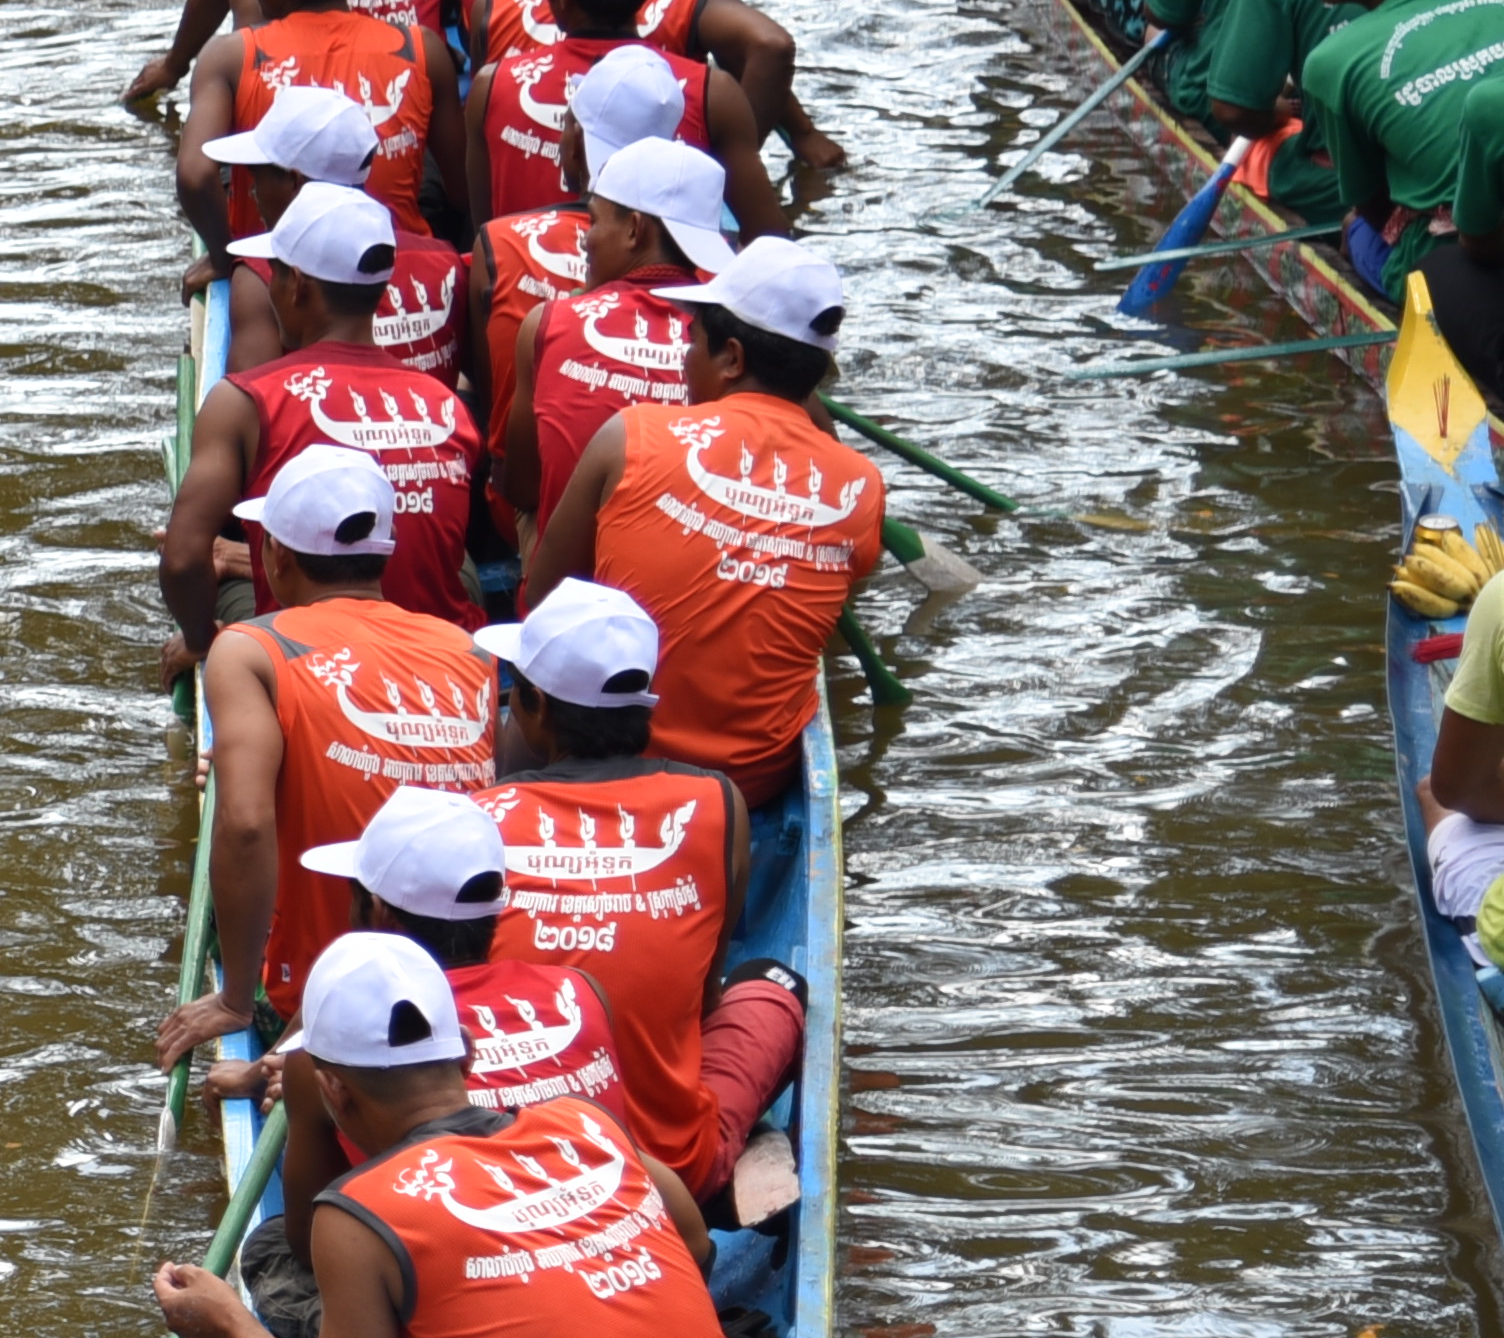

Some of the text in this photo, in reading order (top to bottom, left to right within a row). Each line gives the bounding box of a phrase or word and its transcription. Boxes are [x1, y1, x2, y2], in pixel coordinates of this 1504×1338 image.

[394, 487, 433, 514] ០១៨
[717, 551, 789, 588] ២០១៨
[528, 850, 633, 873] បុណ្យអុំទូក
[636, 893, 646, 911] &
[534, 919, 617, 951] ២០១៨
[511, 1180, 606, 1227] បុណ្យអុំទូក
[578, 1247, 661, 1299] ២០១៨
